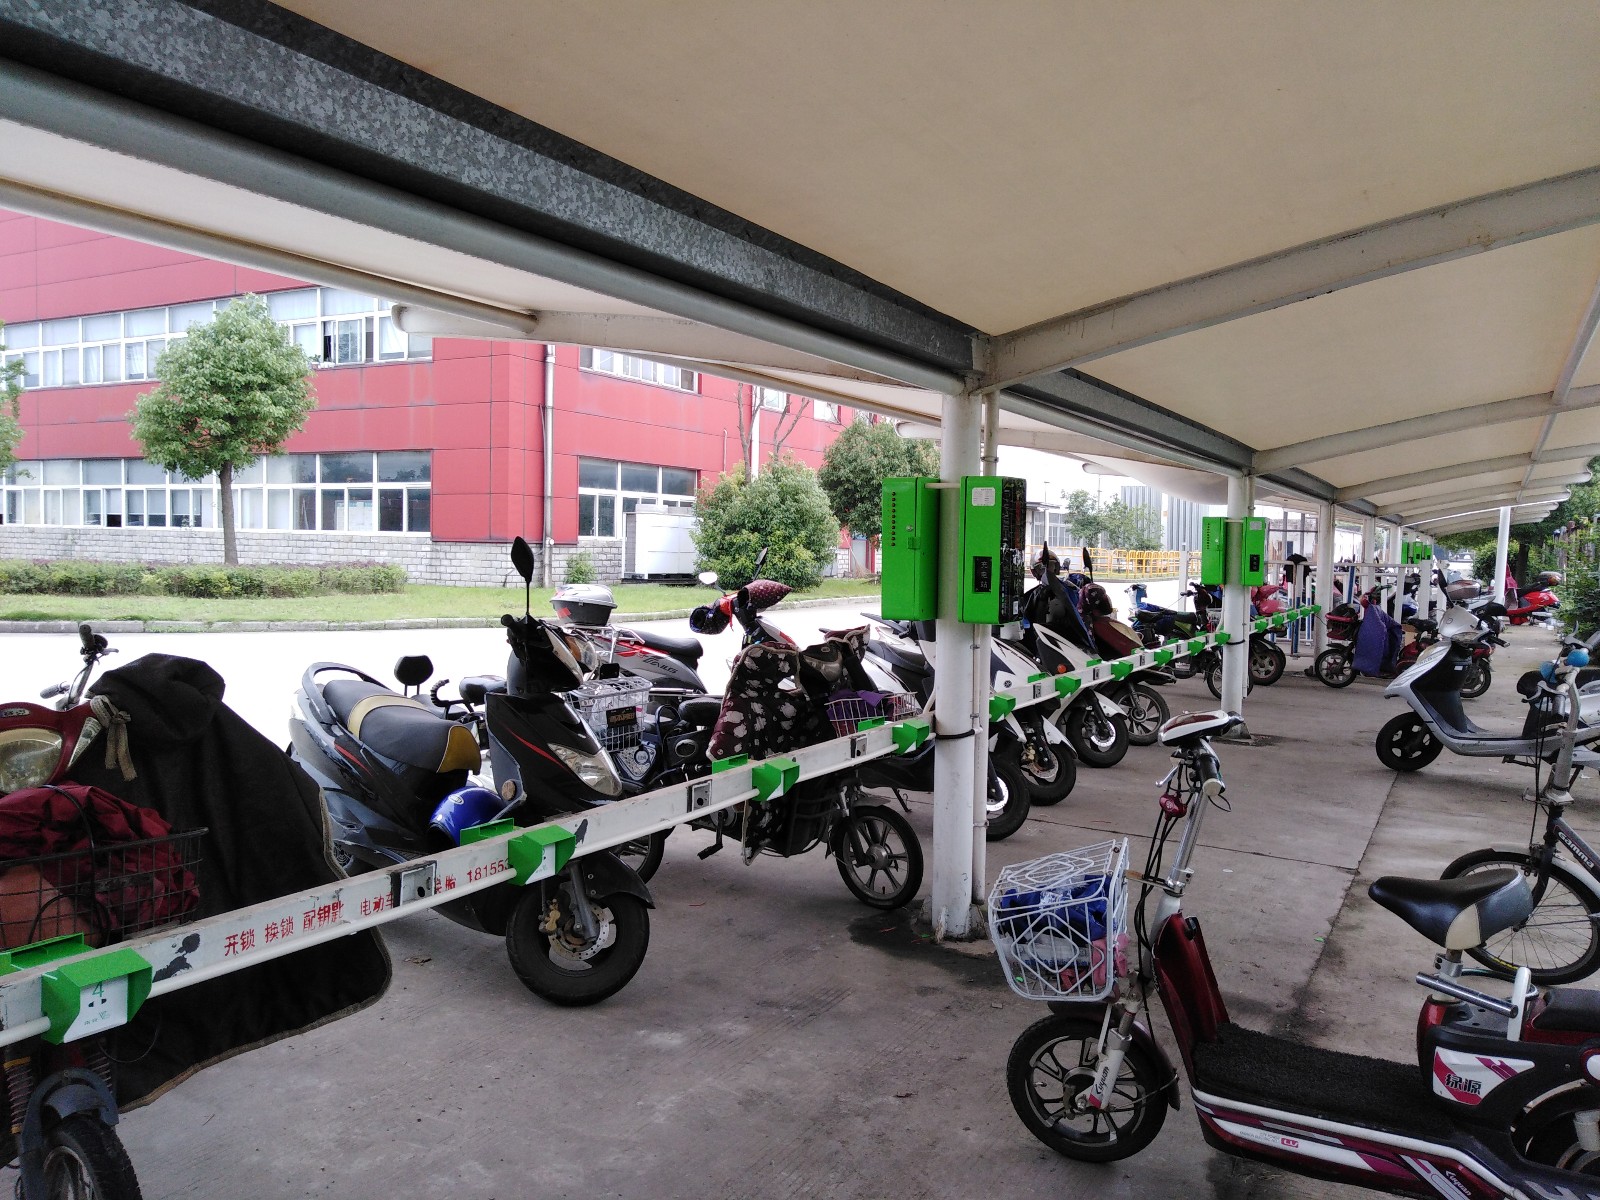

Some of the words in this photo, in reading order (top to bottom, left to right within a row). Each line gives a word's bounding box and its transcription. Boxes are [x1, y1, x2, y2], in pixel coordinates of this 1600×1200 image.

[224, 928, 256, 957] 开锁
[265, 916, 294, 944] 换锁
[303, 900, 344, 931] 配钥匙
[92, 982, 105, 998] 4
[1445, 1072, 1483, 1096] 绿源
